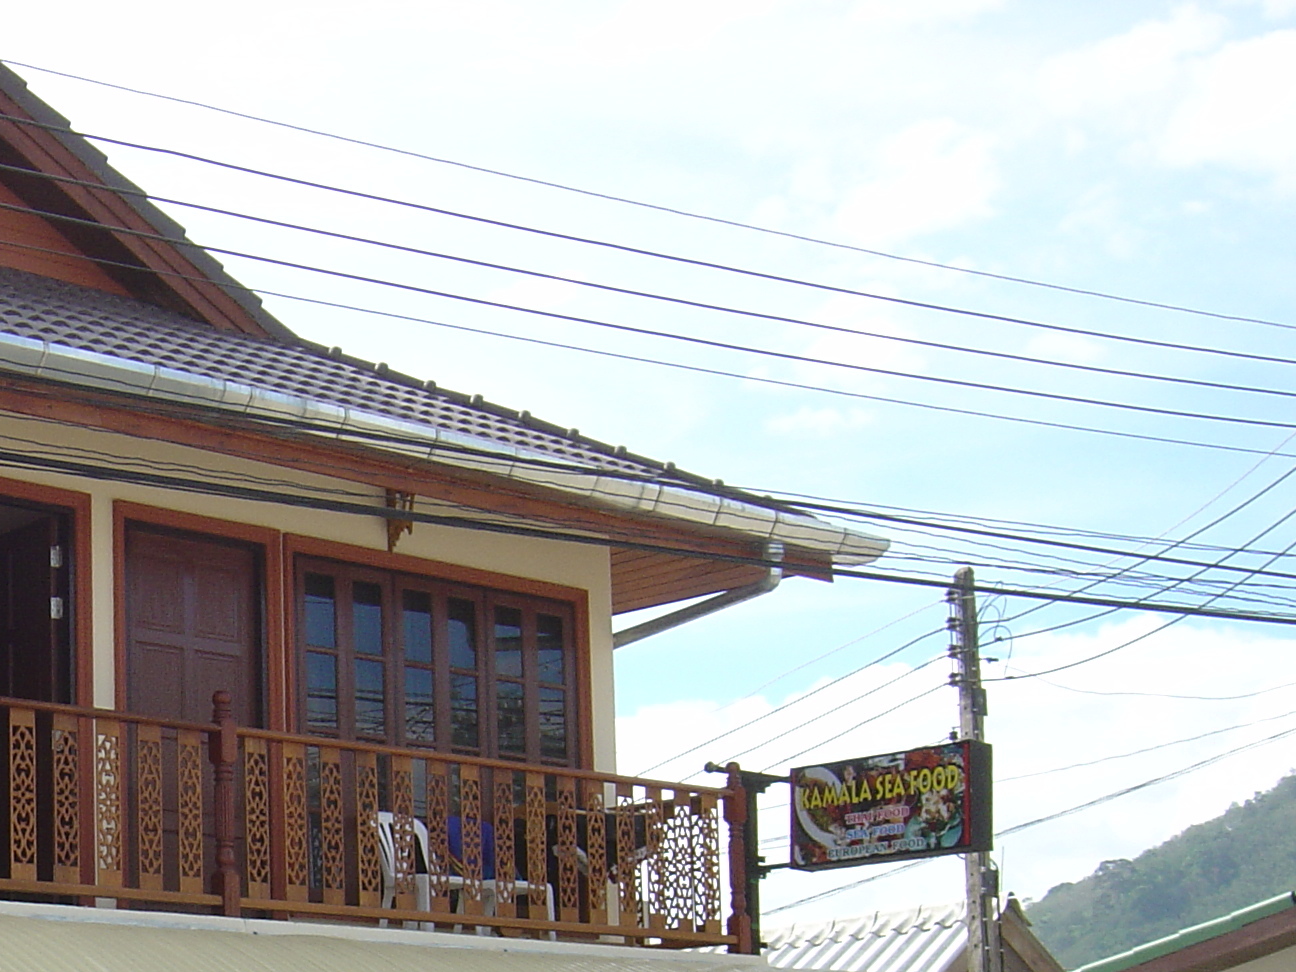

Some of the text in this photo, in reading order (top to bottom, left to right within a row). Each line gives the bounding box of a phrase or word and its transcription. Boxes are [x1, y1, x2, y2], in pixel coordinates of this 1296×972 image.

[800, 764, 960, 809] KAMALA SEA FOOD
[845, 805, 910, 825] THAI FOOD
[846, 824, 905, 839] SEA FOOD
[828, 837, 925, 859] EUROPEAN FOOD
